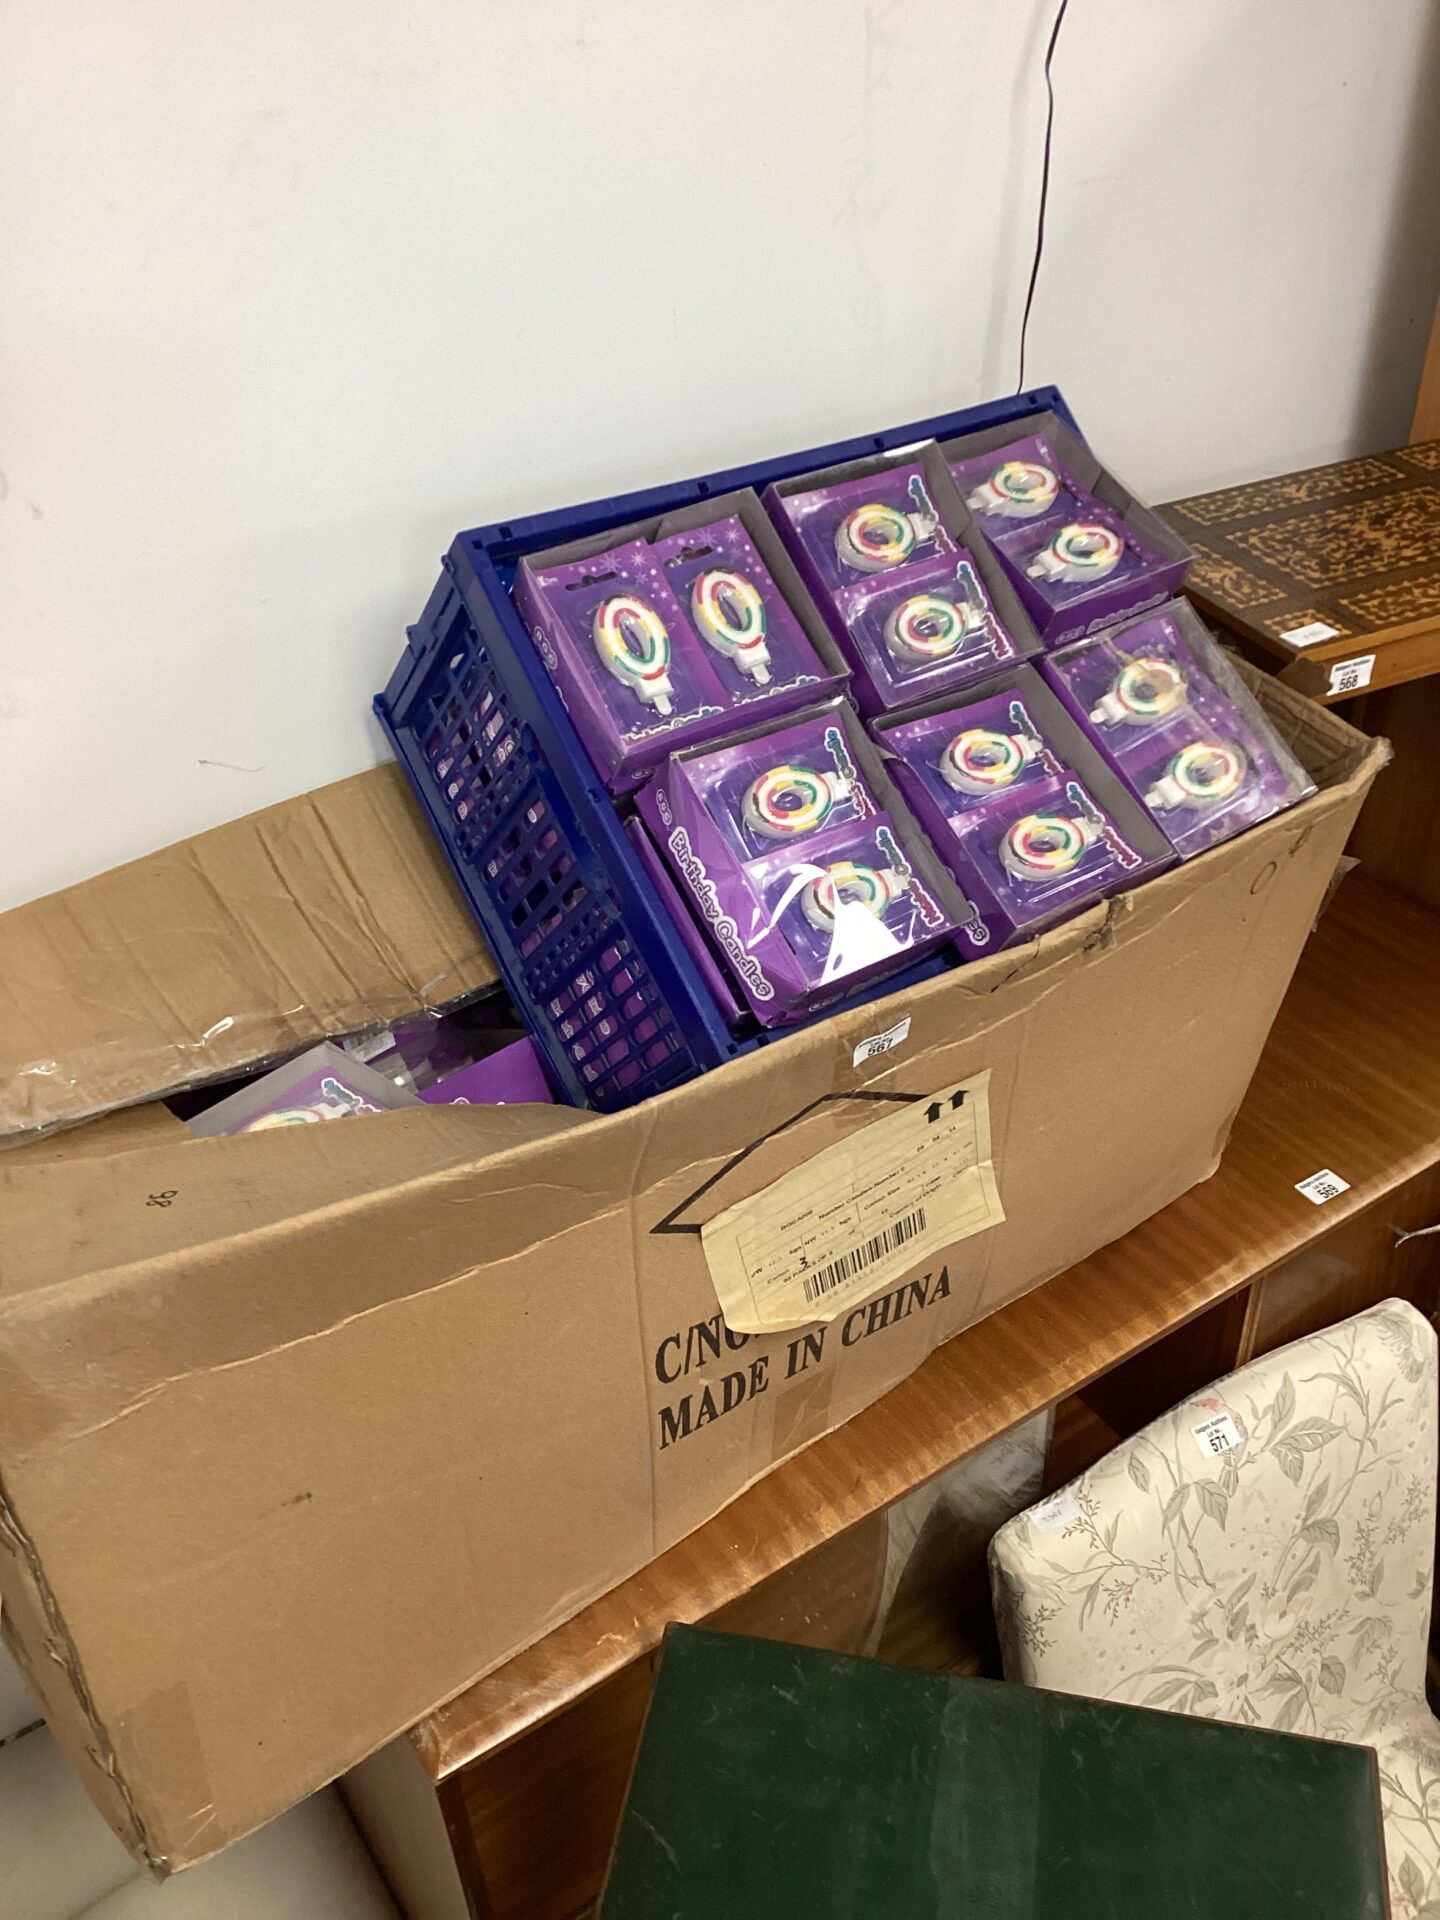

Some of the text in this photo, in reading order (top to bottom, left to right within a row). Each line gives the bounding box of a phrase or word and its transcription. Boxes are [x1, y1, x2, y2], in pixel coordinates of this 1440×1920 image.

[1339, 675, 1358, 691] 568
[669, 828, 773, 998] Birthday Candles
[867, 1037, 893, 1056] 567
[1317, 1184, 1339, 1198] 569
[818, 1203, 845, 1220] Number
[799, 1256, 809, 1272] 3
[658, 1356, 769, 1450] MADE
[784, 1326, 828, 1380] IN
[841, 1265, 951, 1347] CHINA
[1210, 1433, 1230, 1452] 571
